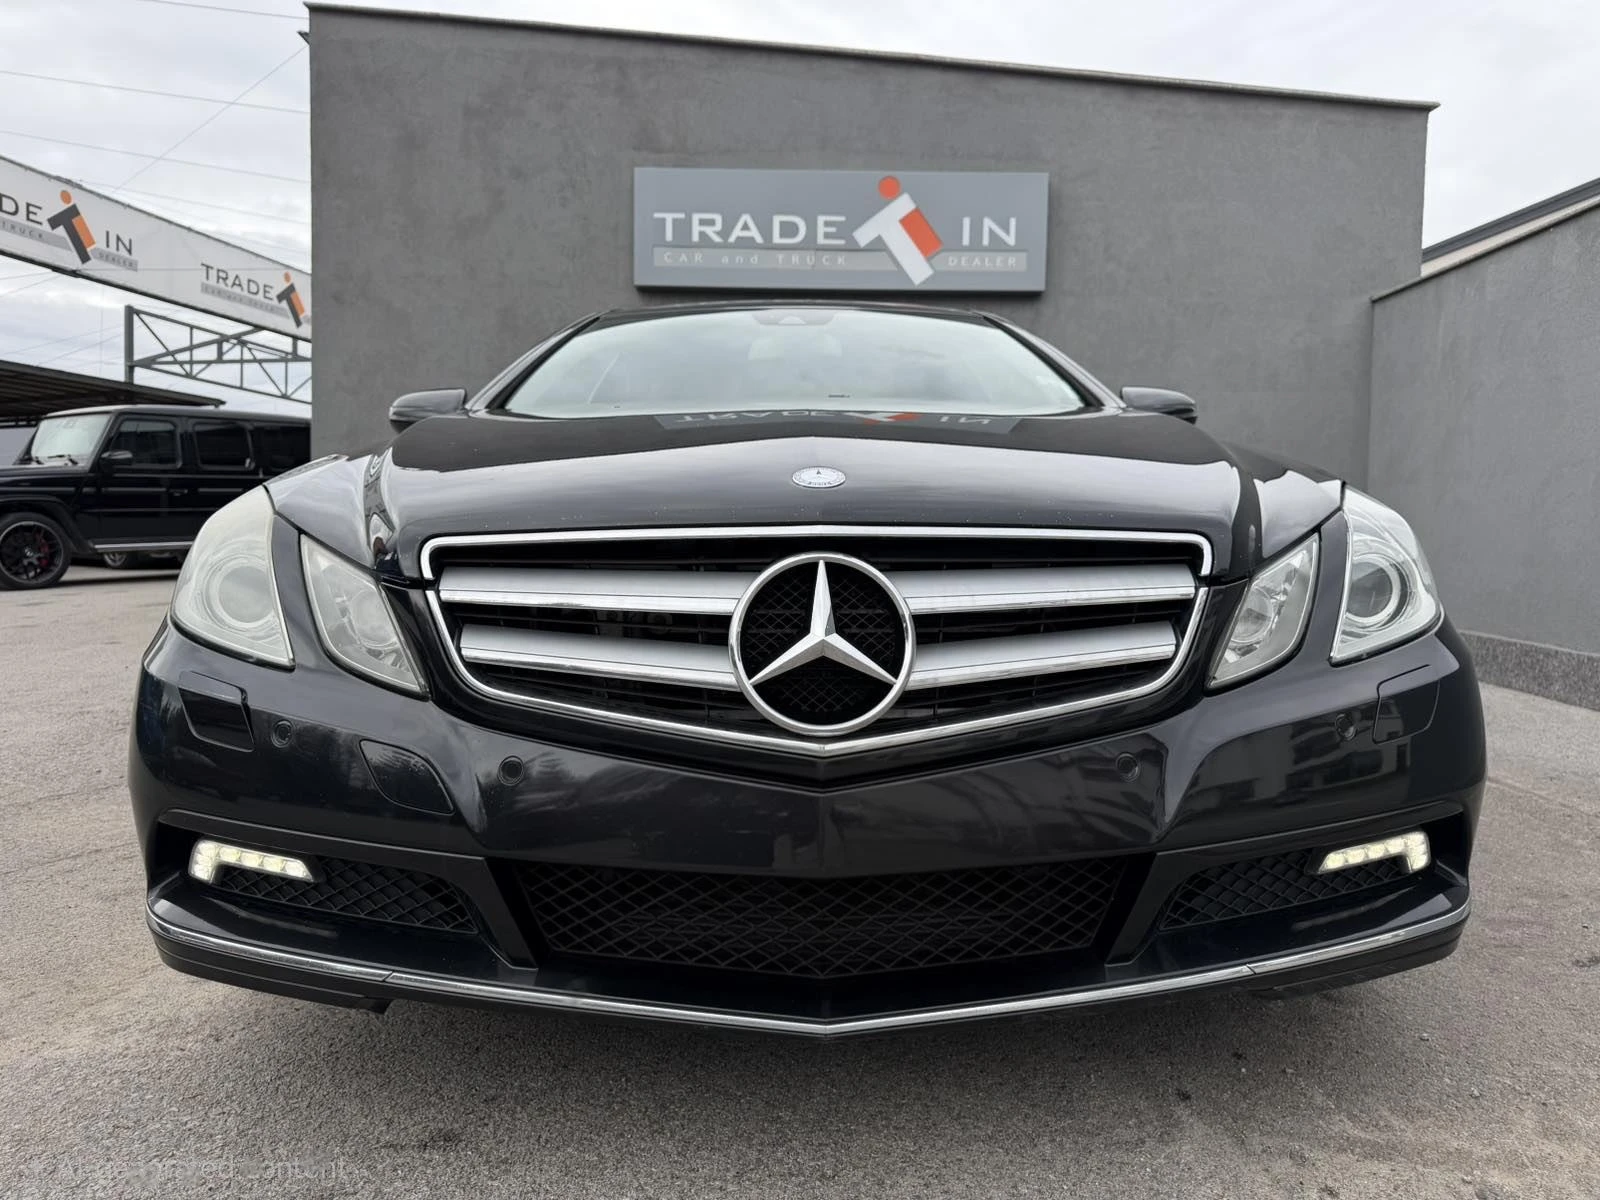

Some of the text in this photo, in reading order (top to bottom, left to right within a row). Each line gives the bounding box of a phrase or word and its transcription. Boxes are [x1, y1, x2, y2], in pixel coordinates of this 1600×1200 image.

[105, 230, 132, 256] IN
[653, 212, 847, 245] TRADE
[962, 216, 1017, 247] IN
[664, 252, 1017, 267] CAR and TRUCK DEALER
[201, 262, 273, 301] TRADE
